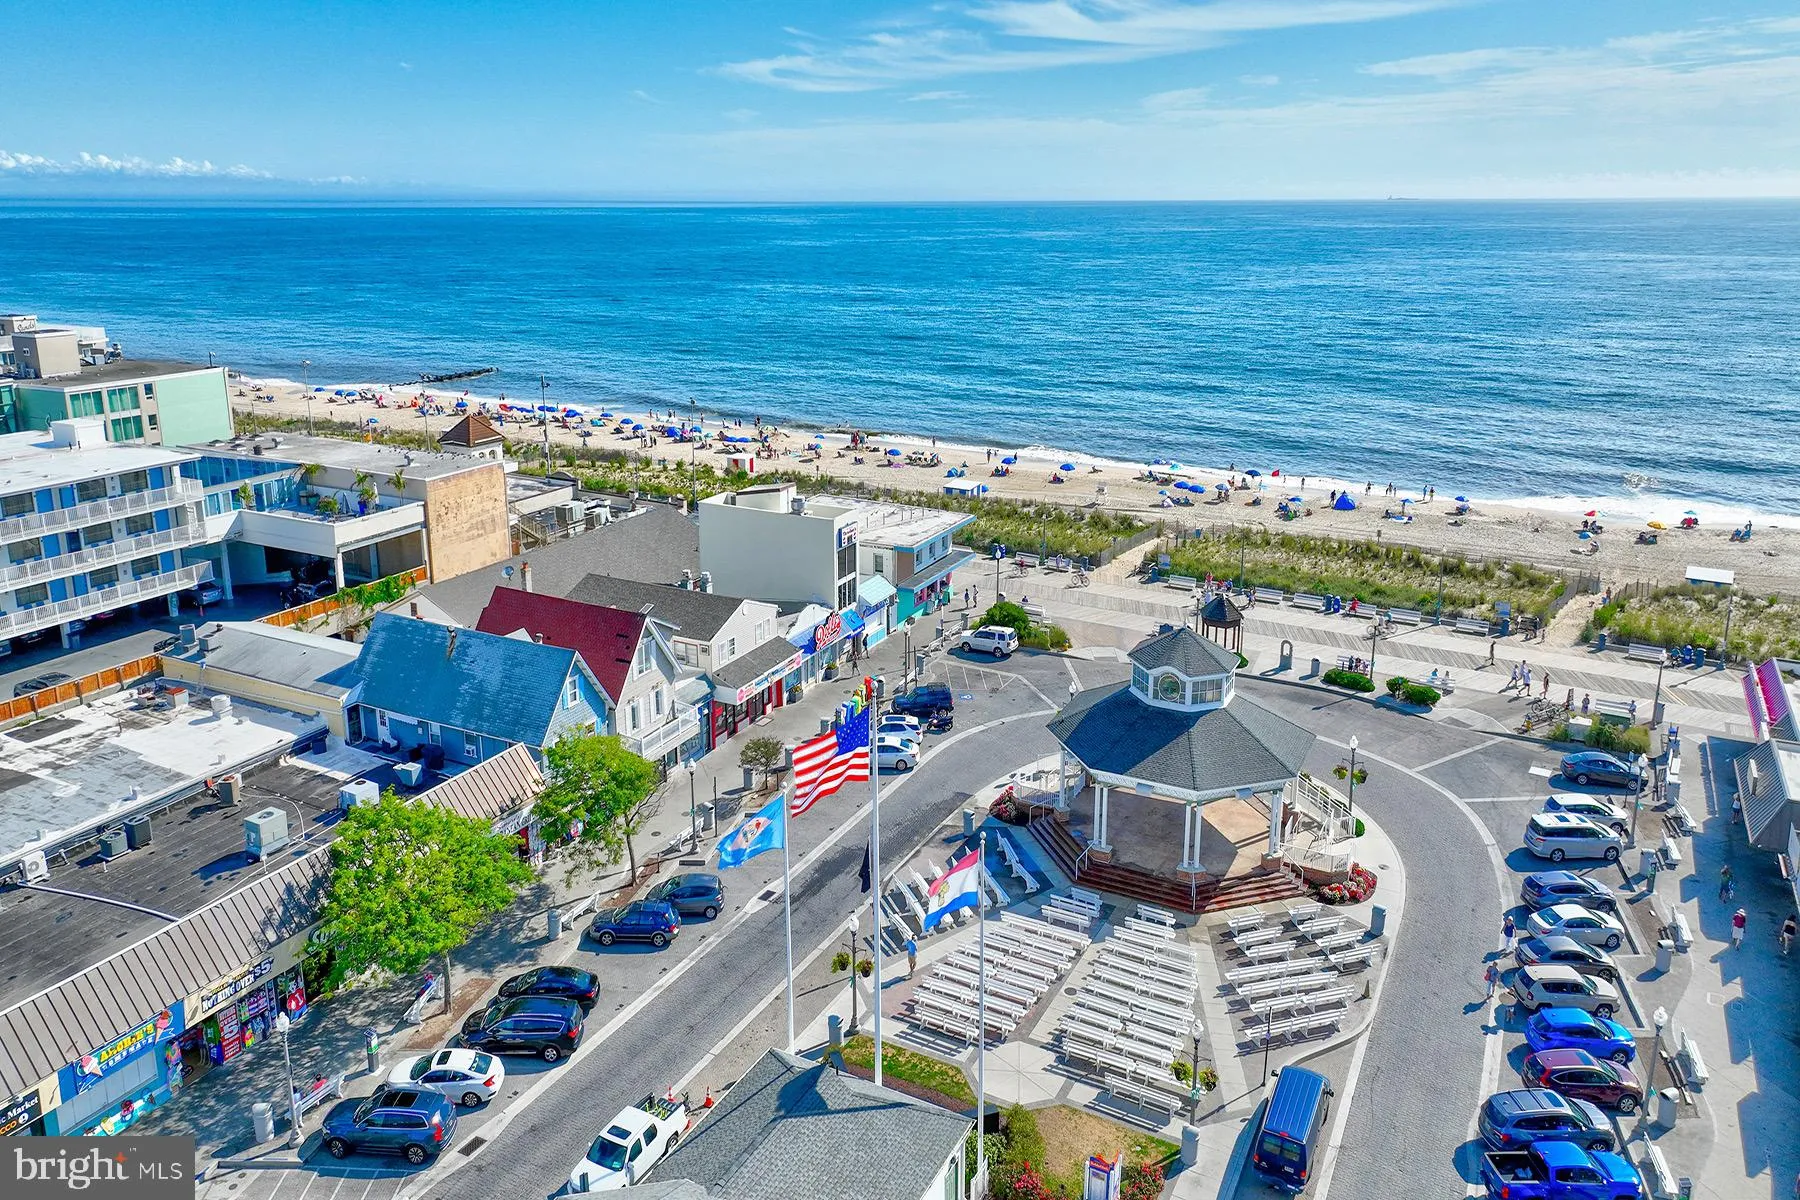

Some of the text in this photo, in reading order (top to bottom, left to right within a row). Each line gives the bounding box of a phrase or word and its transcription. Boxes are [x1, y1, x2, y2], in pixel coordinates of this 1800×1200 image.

[202, 982, 236, 1012] NOTHING
[235, 972, 255, 992] OVER
[7, 1096, 39, 1120] Market
